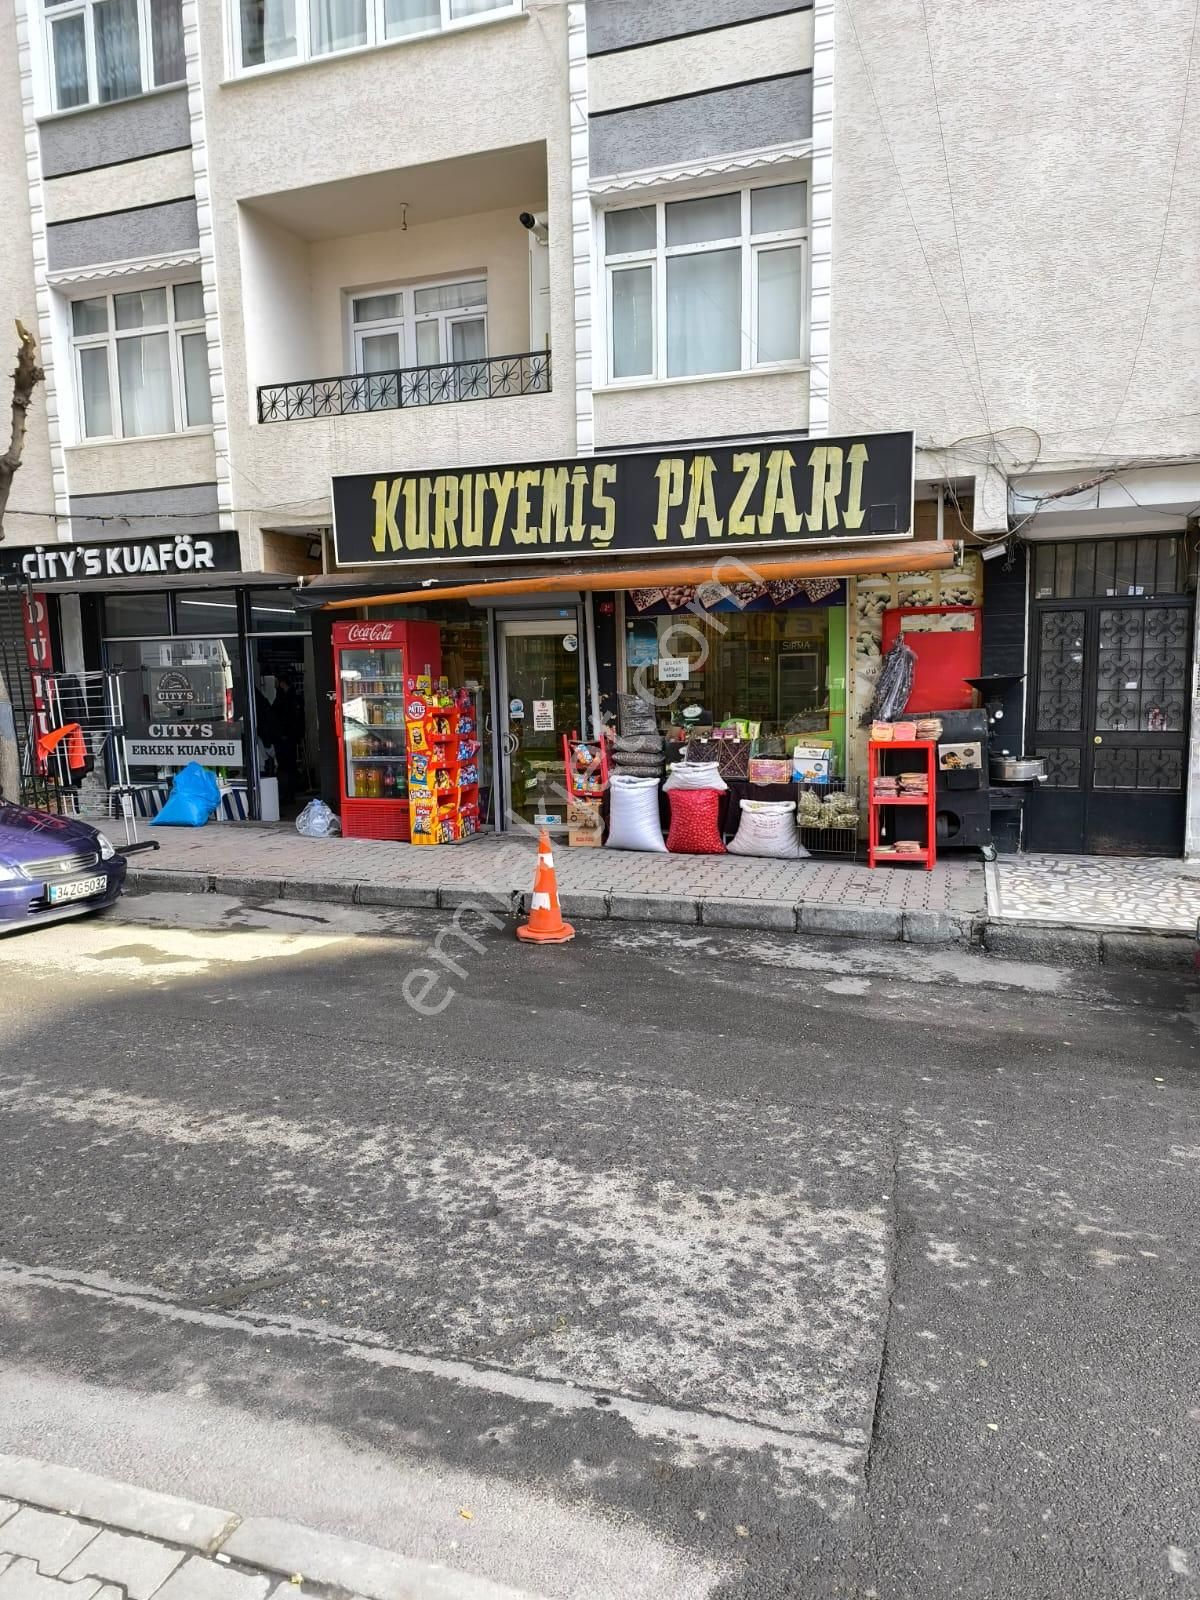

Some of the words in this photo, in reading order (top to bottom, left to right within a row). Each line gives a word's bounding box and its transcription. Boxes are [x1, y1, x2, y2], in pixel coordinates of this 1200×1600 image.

[371, 463, 617, 552] KURUYEMİŞ
[653, 443, 869, 541] PAZARI
[22, 546, 101, 579] CİTY'S
[106, 535, 215, 574] KUAFÖR
[158, 692, 194, 700] CITY'S
[148, 724, 213, 738] CITY'S
[132, 745, 174, 756] ERKEK
[177, 742, 235, 756] KUAFÖRÜ
